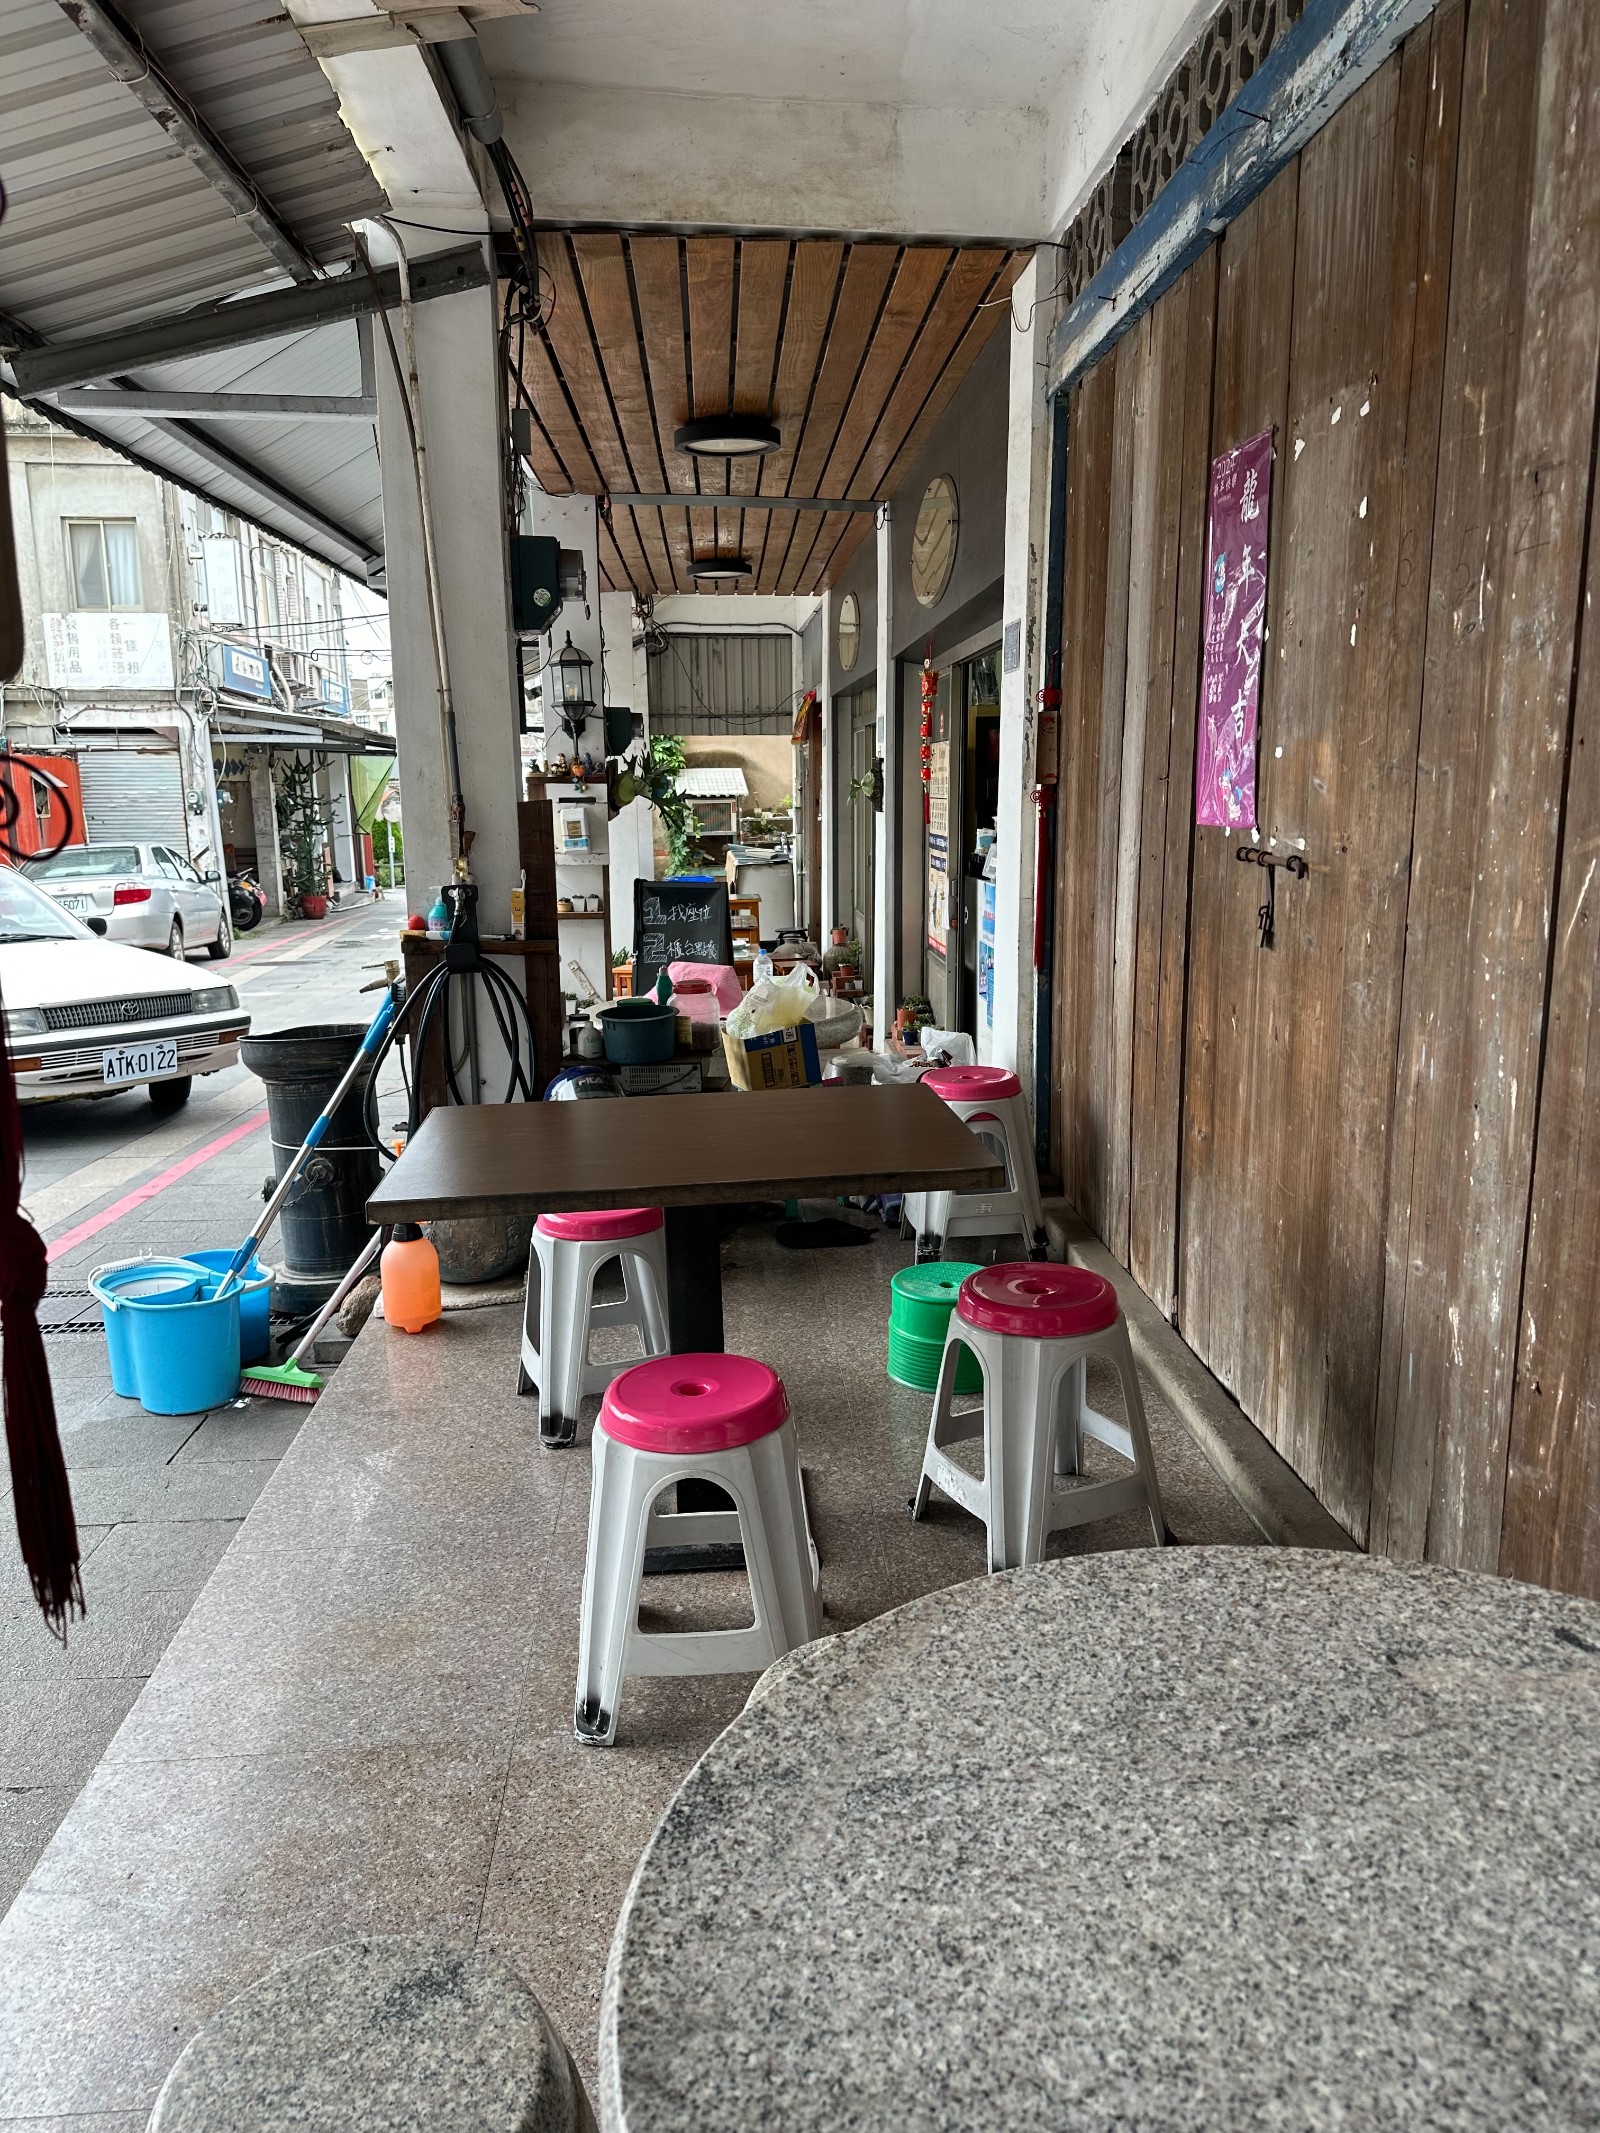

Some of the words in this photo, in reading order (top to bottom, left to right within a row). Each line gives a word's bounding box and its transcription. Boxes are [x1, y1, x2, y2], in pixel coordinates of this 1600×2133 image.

[1216, 457, 1236, 480] 2024
[1231, 468, 1260, 739] 龍年大吉
[108, 617, 126, 674] 各類菸酒
[123, 621, 141, 675] 一條根
